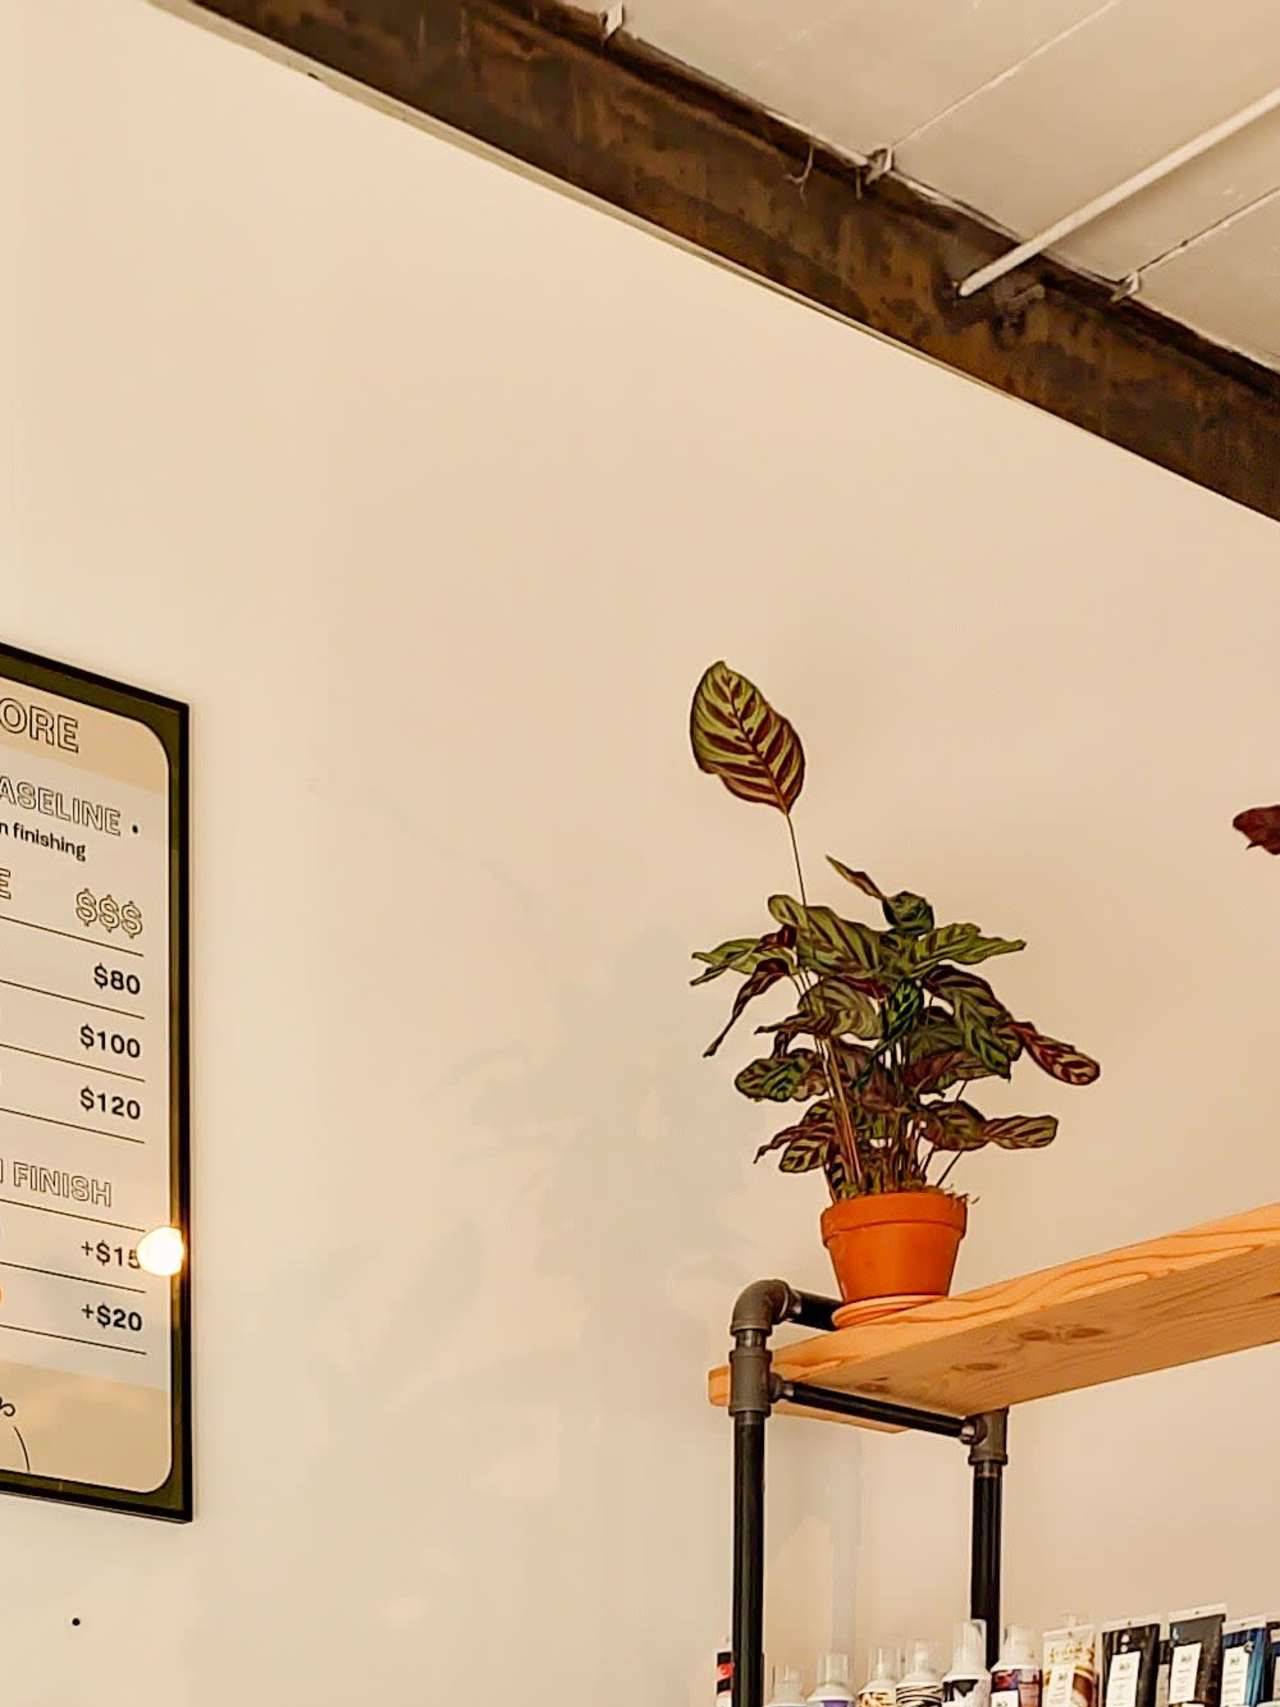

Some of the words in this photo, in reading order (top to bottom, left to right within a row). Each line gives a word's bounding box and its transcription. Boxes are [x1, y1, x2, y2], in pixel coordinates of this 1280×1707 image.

[13, 822, 87, 862] finishing
[76, 887, 143, 939] $$$
[93, 962, 141, 995] $80
[80, 1023, 141, 1059] $100
[80, 1085, 141, 1121] $120
[13, 1161, 112, 1207] FINISH
[80, 1239, 140, 1270] +$15
[80, 1303, 143, 1332] +$20
